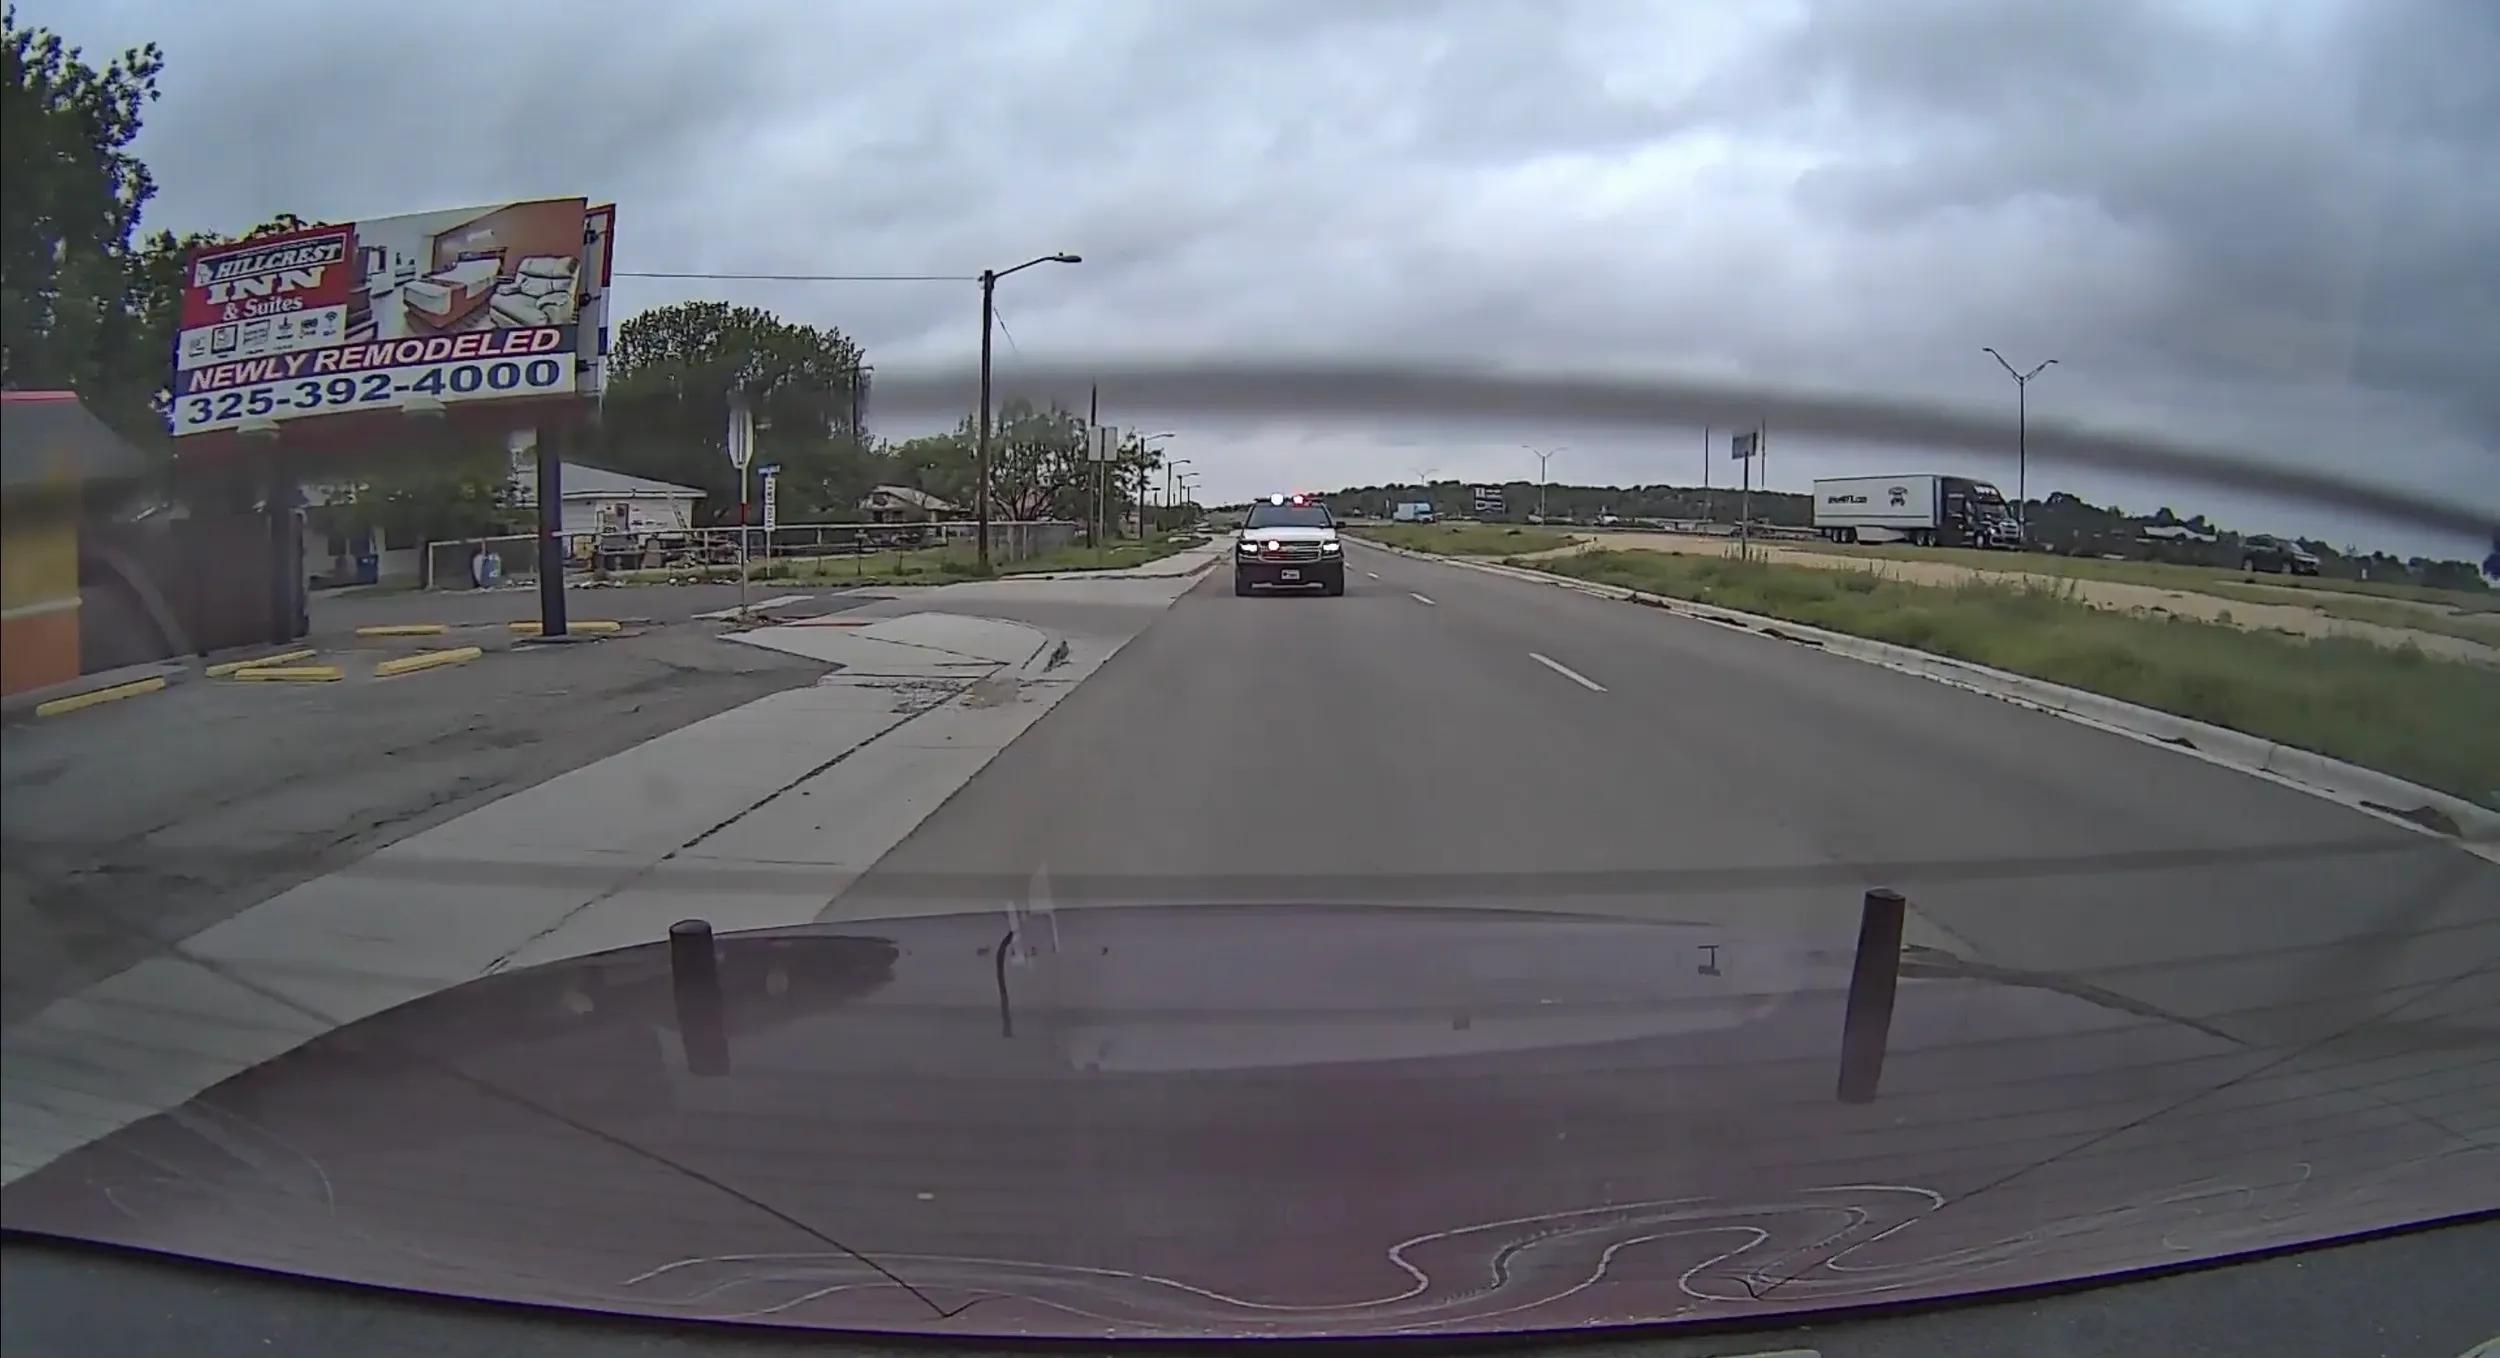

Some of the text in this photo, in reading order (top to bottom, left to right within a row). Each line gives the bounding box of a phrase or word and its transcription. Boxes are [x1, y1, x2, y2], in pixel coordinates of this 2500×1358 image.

[215, 242, 342, 279] HILLCREST
[206, 266, 326, 304] INN
[222, 296, 304, 321] & Suites
[188, 328, 561, 392] NEWLY REMODELED
[188, 359, 561, 425] 325-392-4000
